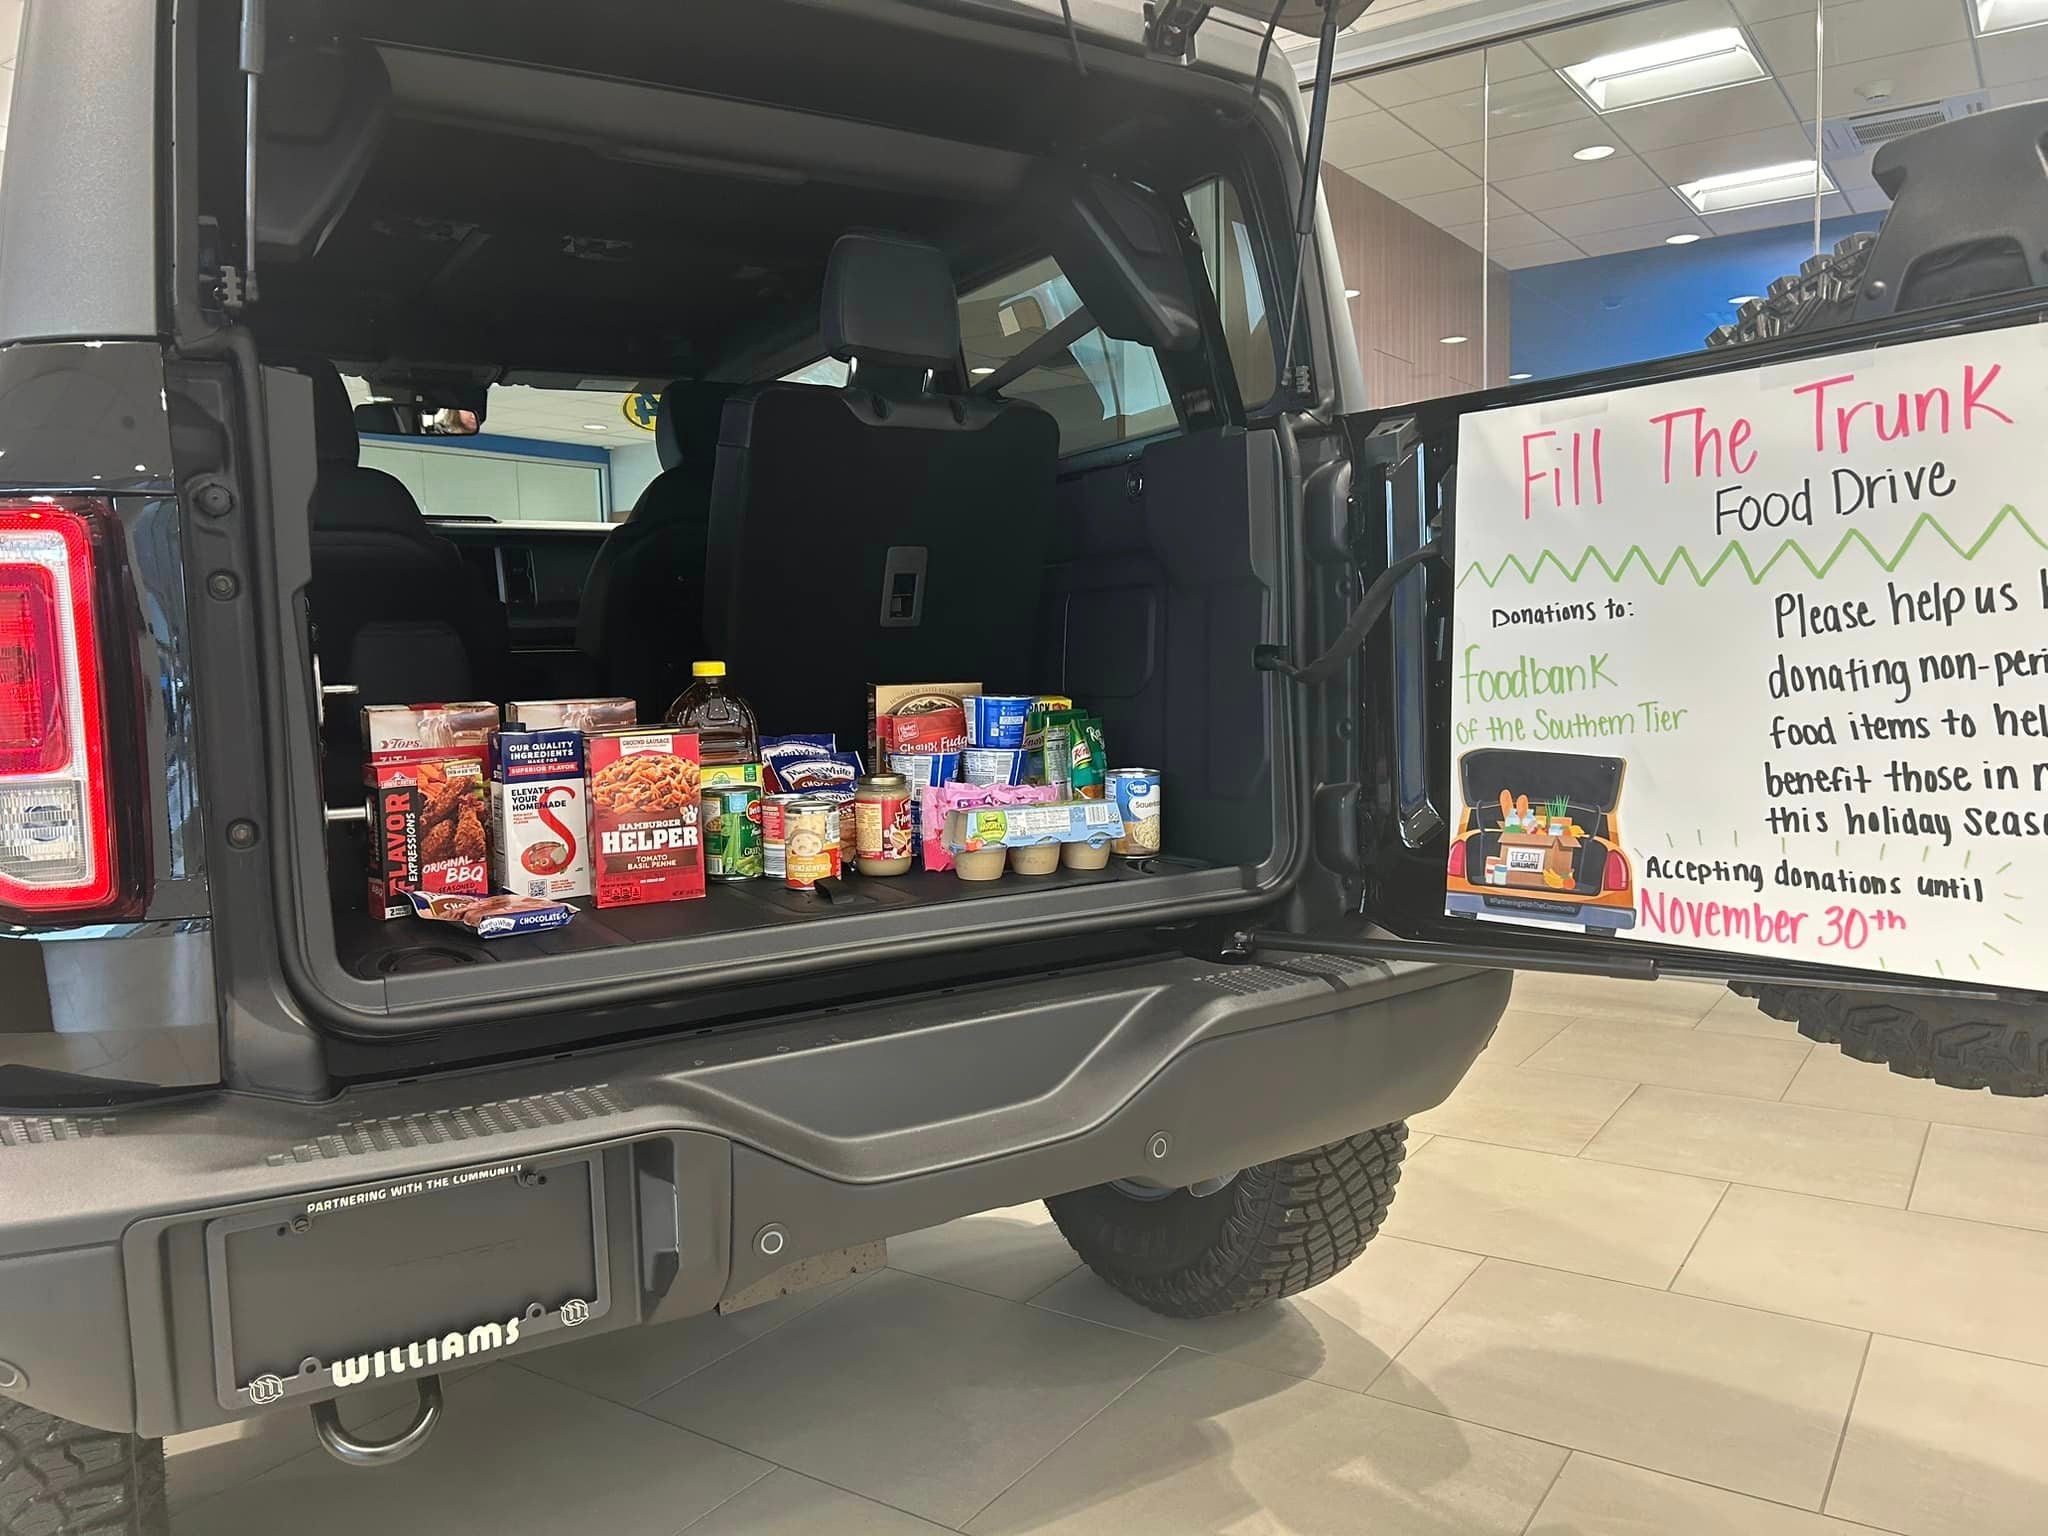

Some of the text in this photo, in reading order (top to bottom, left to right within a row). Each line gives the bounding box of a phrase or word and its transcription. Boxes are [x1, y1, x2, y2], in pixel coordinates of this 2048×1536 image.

[1523, 427, 1603, 519] Fill
[1649, 406, 1758, 483] The
[1716, 460, 1957, 535] Food Drive
[1491, 598, 1635, 628] Donations to:
[1774, 592, 1876, 638] Please
[1887, 581, 1966, 627] help
[1974, 582, 2019, 615] us
[1768, 654, 1912, 703] donating
[1456, 701, 1688, 745] of the Southern Tier
[1769, 715, 1837, 749] food
[1848, 711, 1931, 740] items
[1941, 708, 1977, 738] to
[509, 741, 574, 752] OUR QUALITY
[510, 749, 574, 760] INGREDIENTS
[511, 766, 546, 774] SUPERIOR
[1764, 761, 1872, 798] benefit
[1883, 760, 1972, 793] those
[1983, 760, 2019, 790] in
[512, 786, 550, 796] ELEVATE
[512, 796, 538, 804] YOUR
[512, 800, 567, 811] HOMEMADE
[601, 826, 699, 854] HELPER
[618, 819, 681, 831] HAMBURGER
[1765, 806, 1829, 834] this
[1844, 803, 1952, 847] holiday
[385, 792, 415, 896] FLAVOR
[406, 812, 418, 882] EXPRESSIONS
[636, 854, 668, 863] TOMATO
[1511, 851, 1540, 862] TEAM
[422, 855, 473, 874] ORIGINAL
[445, 866, 485, 883] BBQ
[627, 860, 677, 871] BASIL PENNE
[1646, 855, 1984, 902] Accepting donations until
[1640, 887, 1907, 949] November 30th
[306, 1189, 387, 1214] PARTNERING
[390, 1180, 423, 1198] WITH
[427, 1176, 449, 1190] THE
[332, 1317, 520, 1388] WILLIAMS
